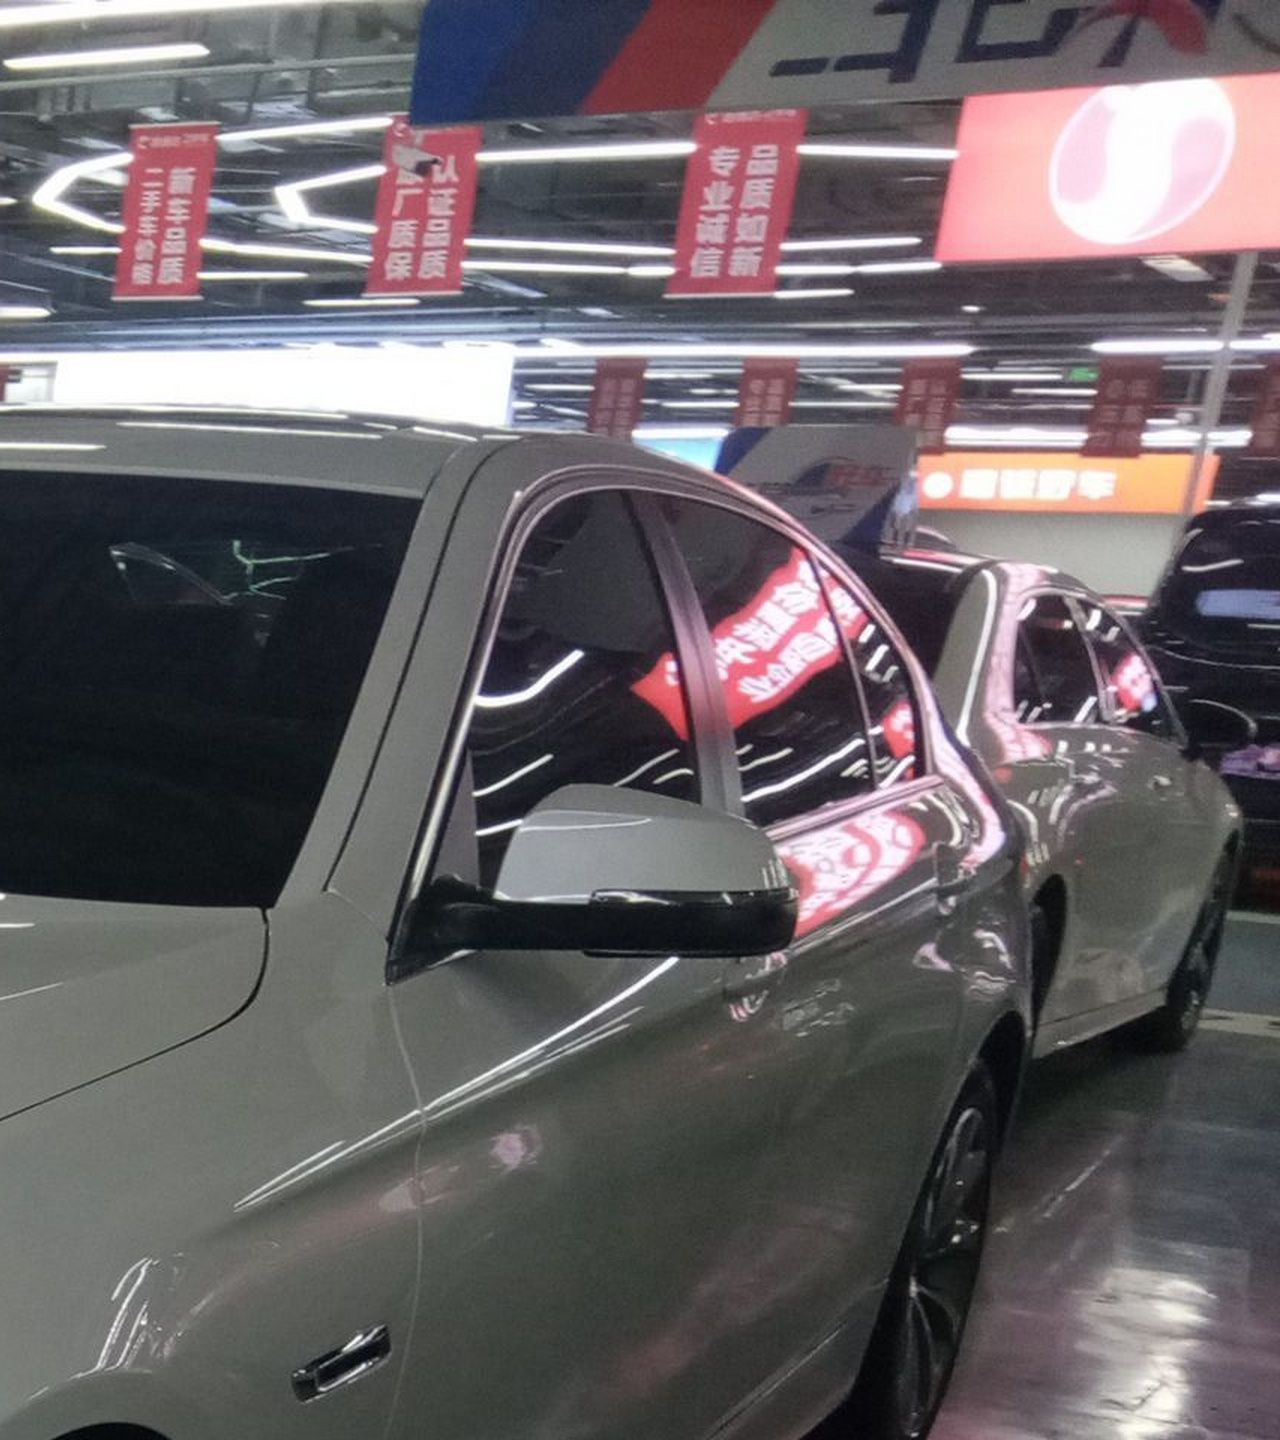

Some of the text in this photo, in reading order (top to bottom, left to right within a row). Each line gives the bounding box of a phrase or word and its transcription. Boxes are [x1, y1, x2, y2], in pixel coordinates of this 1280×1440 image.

[131, 167, 165, 285] 二手车价格
[156, 166, 197, 285] 新车品质
[690, 145, 740, 278] 专业诚信
[727, 143, 780, 278] 品质如新
